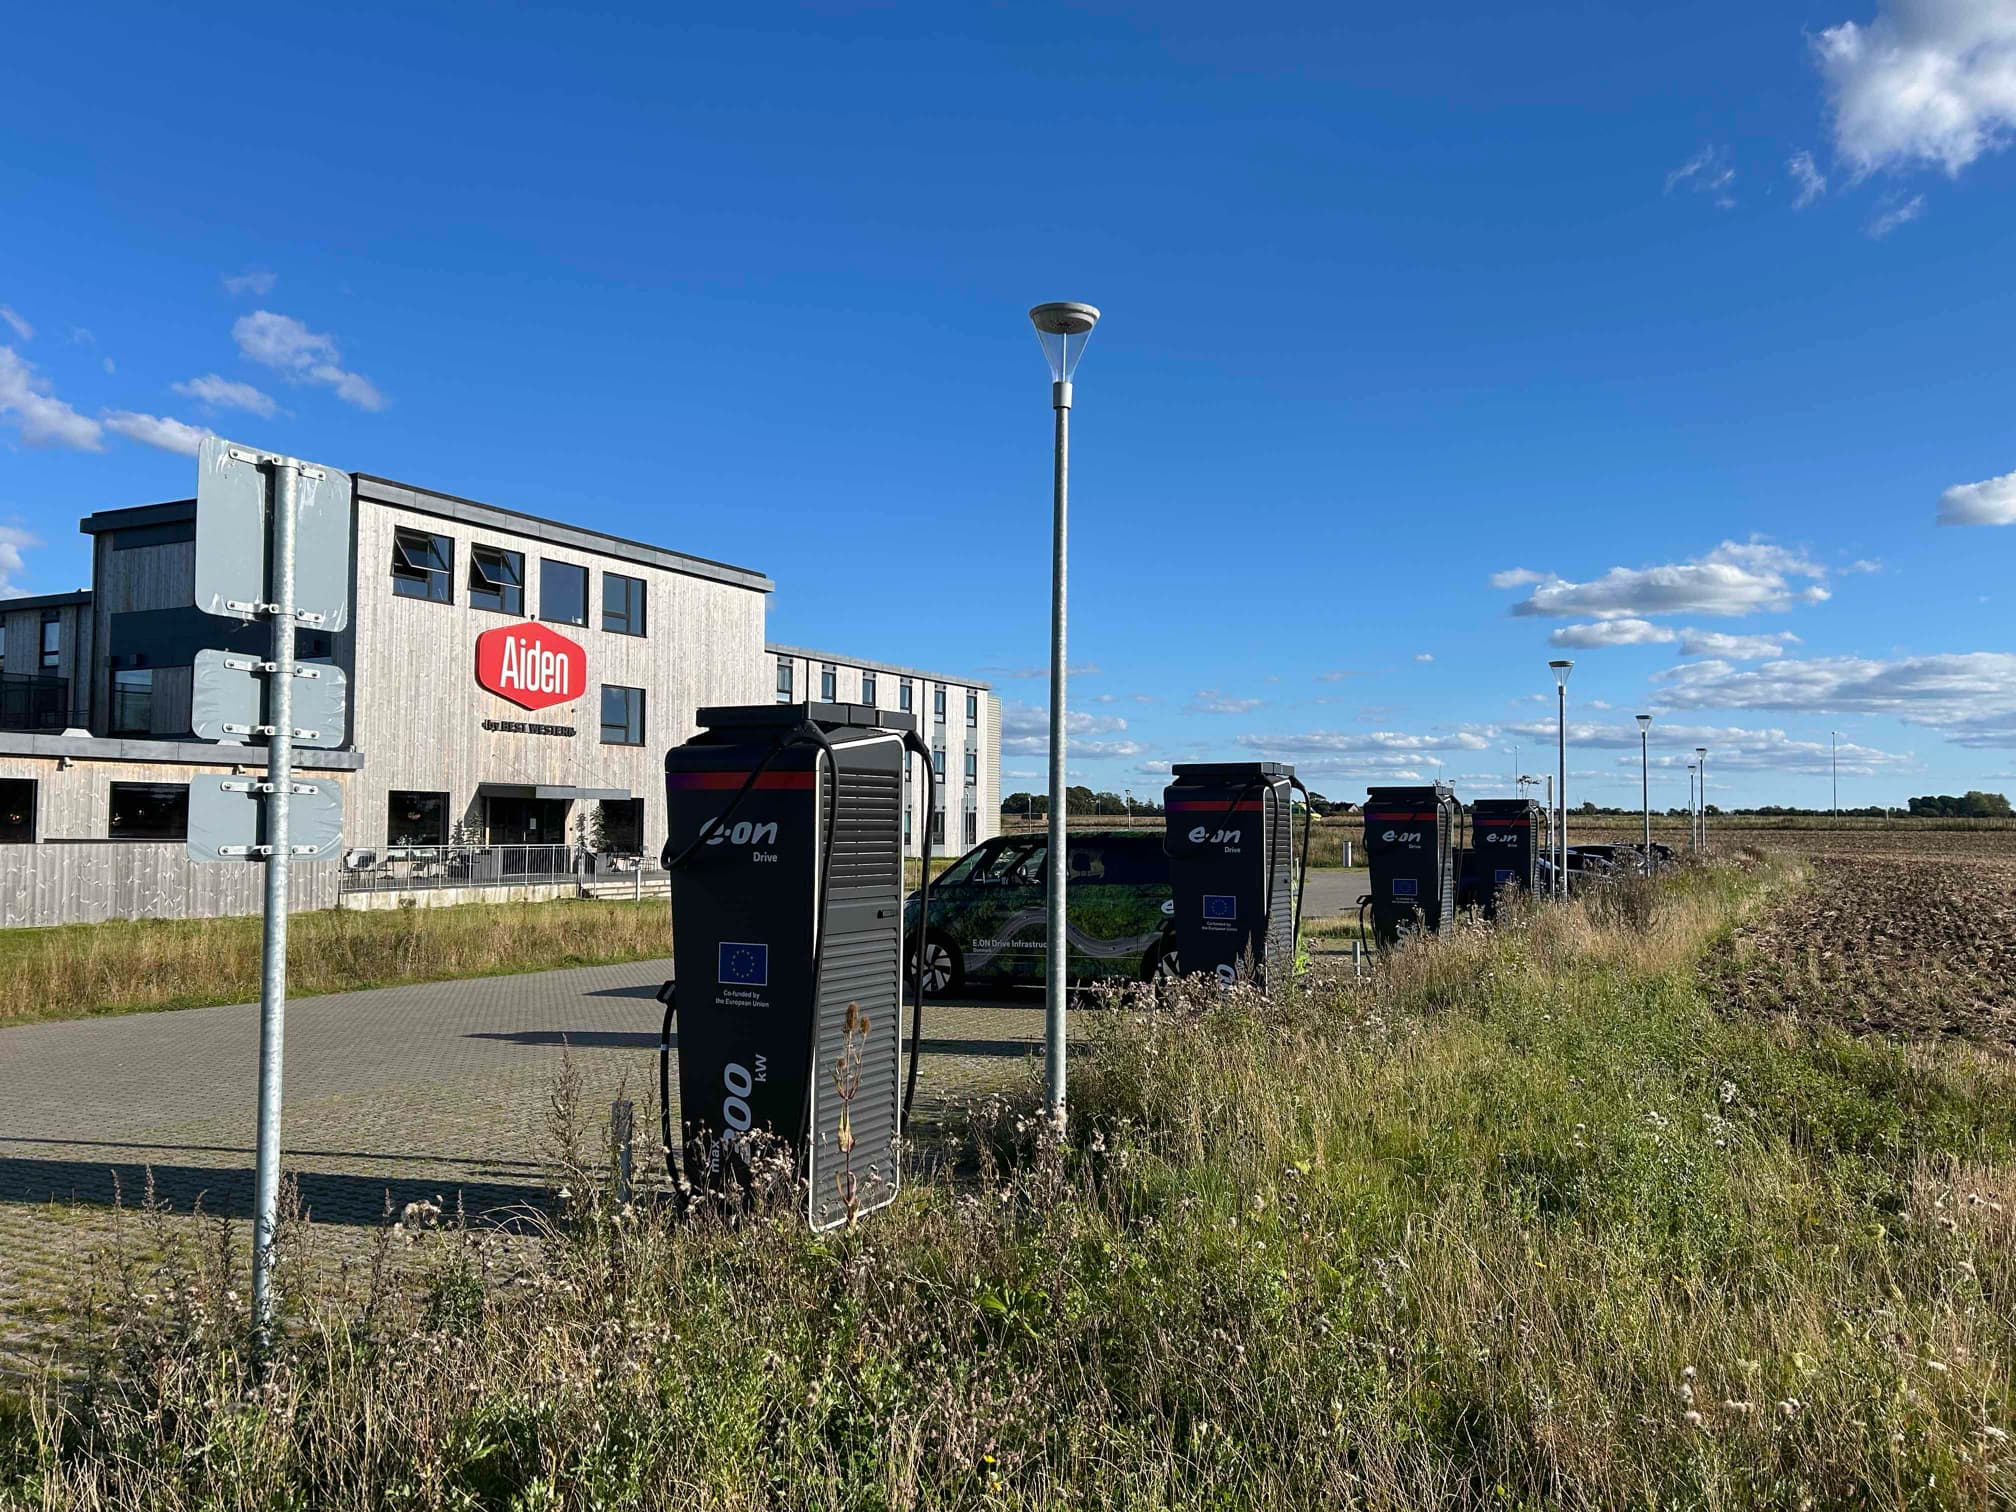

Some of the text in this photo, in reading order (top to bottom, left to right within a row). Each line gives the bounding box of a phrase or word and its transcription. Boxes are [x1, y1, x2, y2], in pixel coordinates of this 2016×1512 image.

[500, 635, 569, 695] Aiden
[501, 721, 527, 733] BEST
[528, 724, 576, 737] WESTERN
[752, 851, 778, 862] Drive
[992, 940, 1010, 948] Drive
[1011, 940, 1048, 949] Infrastruc
[752, 991, 760, 1000] by
[725, 998, 752, 1007] European
[752, 1000, 770, 1008] Union
[755, 1054, 767, 1082] kW
